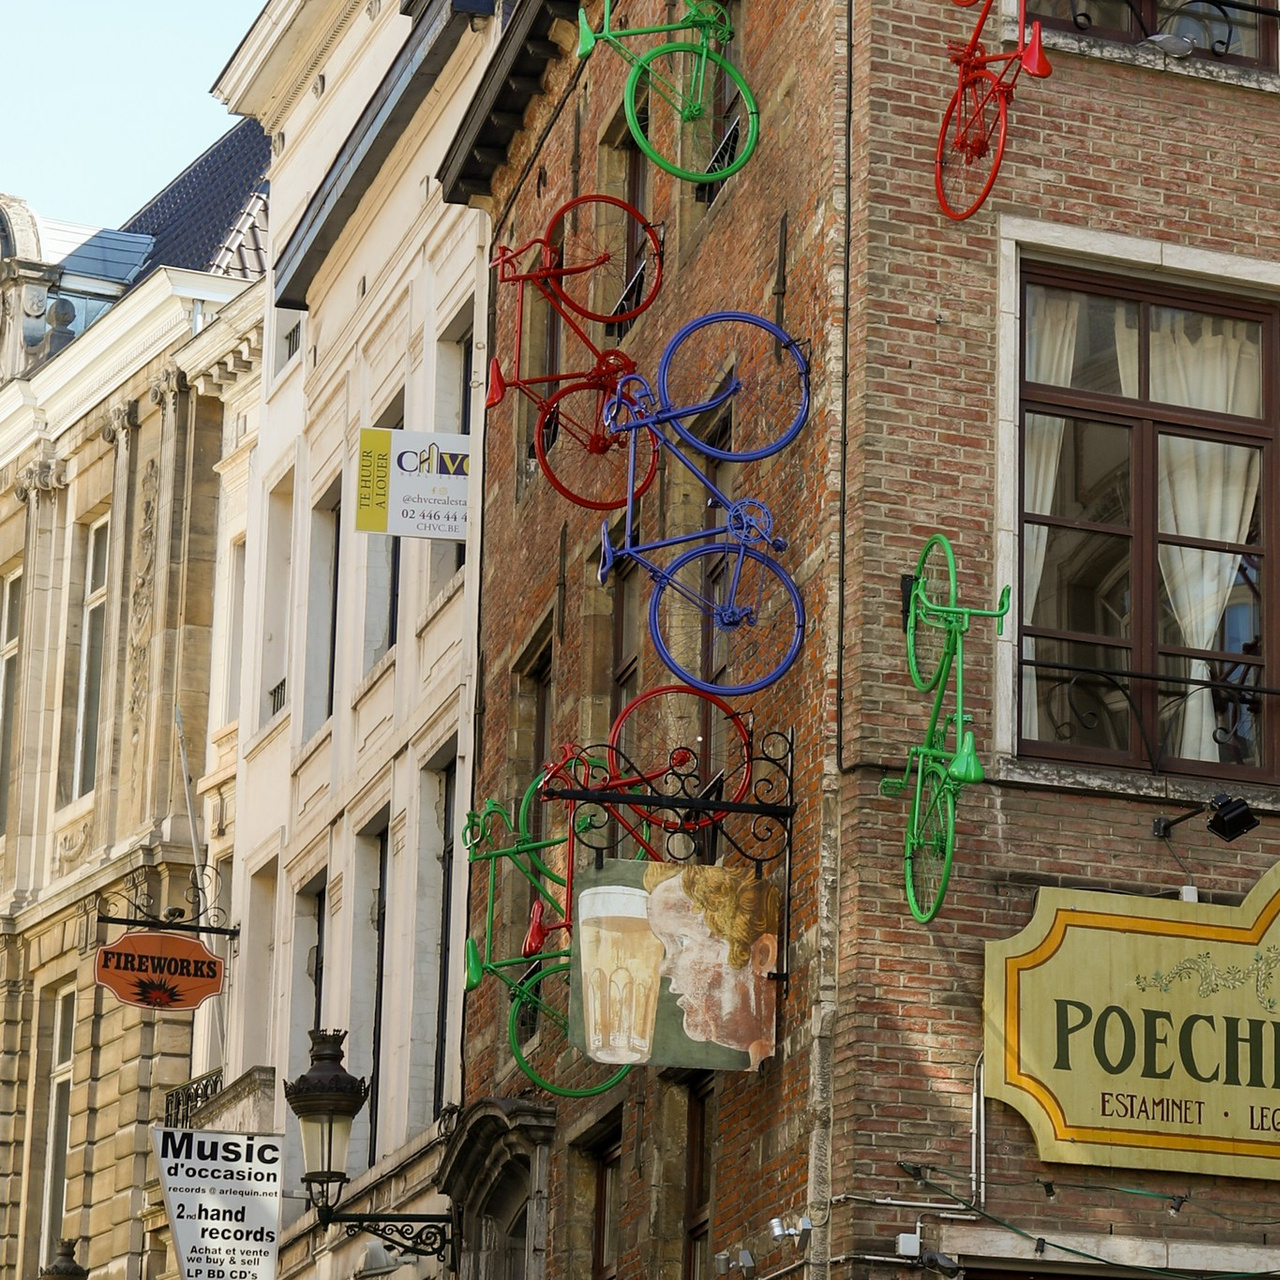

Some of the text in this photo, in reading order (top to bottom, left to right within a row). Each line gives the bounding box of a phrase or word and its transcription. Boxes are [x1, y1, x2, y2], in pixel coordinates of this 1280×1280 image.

[360, 450, 373, 509] TE HUUR
[376, 453, 388, 497] LOUER
[402, 509, 416, 519] 02
[419, 509, 441, 521] 446
[444, 510, 458, 521] 44
[417, 523, 460, 533] CHVC.BE
[102, 951, 217, 979] FIREWORKS
[1100, 1092, 1205, 1126] ESTAMINET
[161, 1131, 280, 1164] Music
[167, 1163, 277, 1182] d'occasion
[168, 1186, 278, 1197] records @ arlequin.net
[197, 1204, 246, 1222] hand
[201, 1227, 275, 1243] records
[190, 1246, 270, 1257] Achat et vente
[187, 1256, 260, 1266] we buy & sell
[187, 1269, 258, 1280] LP BD CD's
